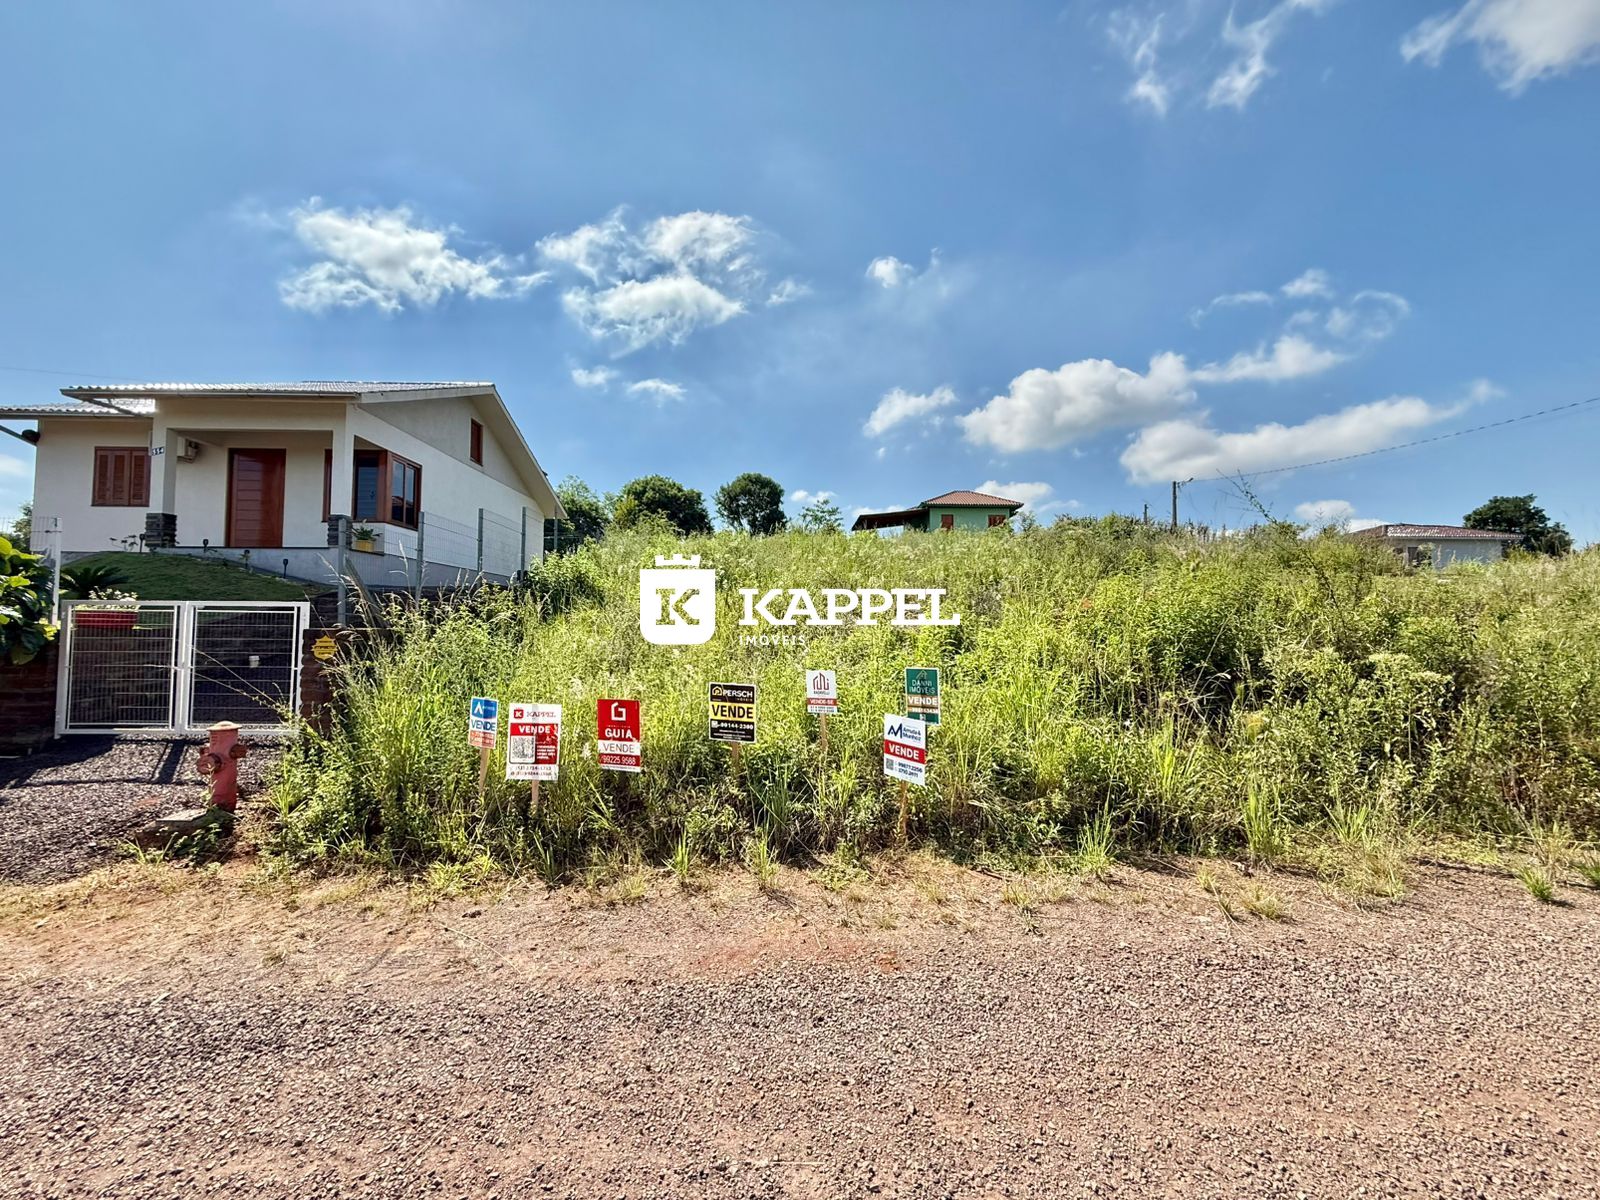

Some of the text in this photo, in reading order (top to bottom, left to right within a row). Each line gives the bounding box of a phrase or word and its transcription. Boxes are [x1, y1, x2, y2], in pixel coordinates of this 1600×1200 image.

[723, 689, 753, 698] PERSCH
[908, 696, 938, 706] VENDE
[712, 704, 754, 719] VENDE
[471, 720, 496, 732] VENDE
[518, 725, 551, 734] VENDE
[605, 728, 633, 739] GUIA
[603, 743, 635, 754] VENDE
[889, 743, 920, 760] VENDE
